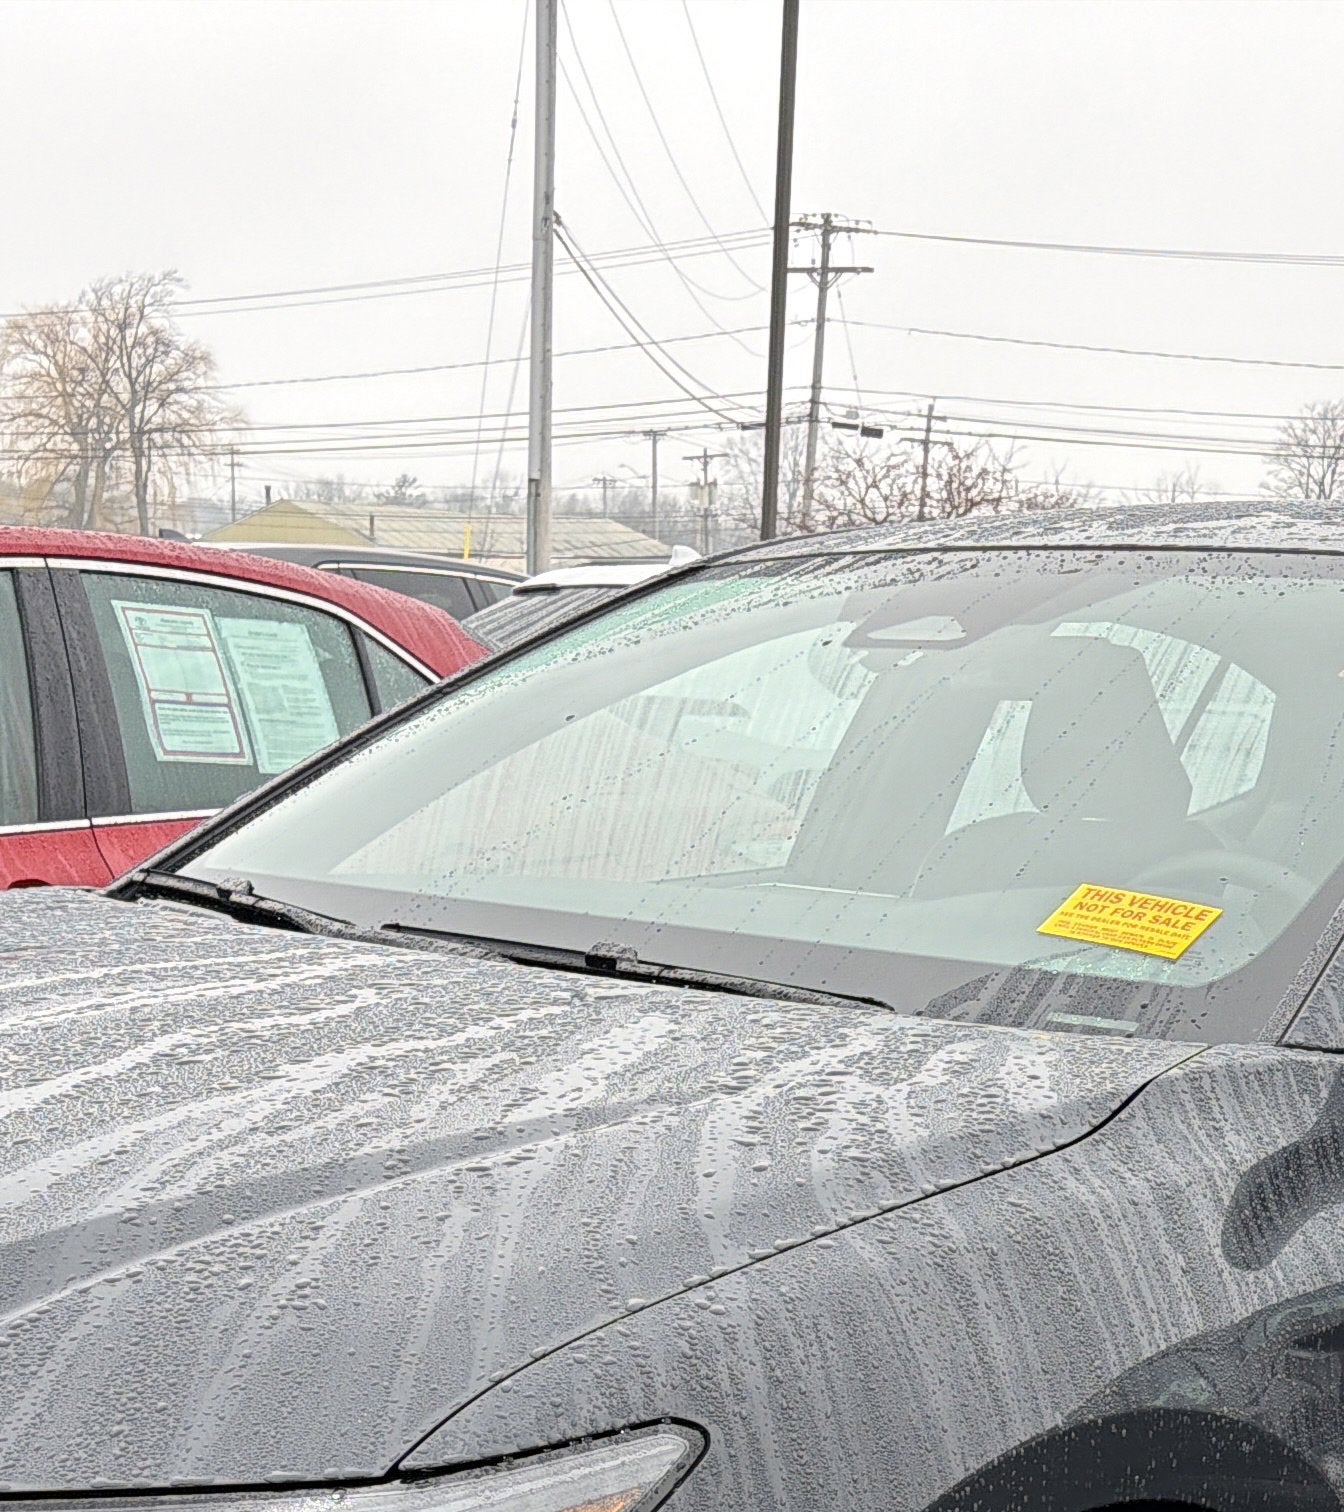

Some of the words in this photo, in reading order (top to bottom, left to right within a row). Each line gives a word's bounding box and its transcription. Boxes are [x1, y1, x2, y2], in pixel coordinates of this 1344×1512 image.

[1073, 902, 1110, 914] NOT
[1110, 908, 1146, 921] FOR
[1148, 915, 1196, 931] SALE
[1082, 888, 1126, 904] THIS
[1128, 896, 1213, 921] VEHICLE
